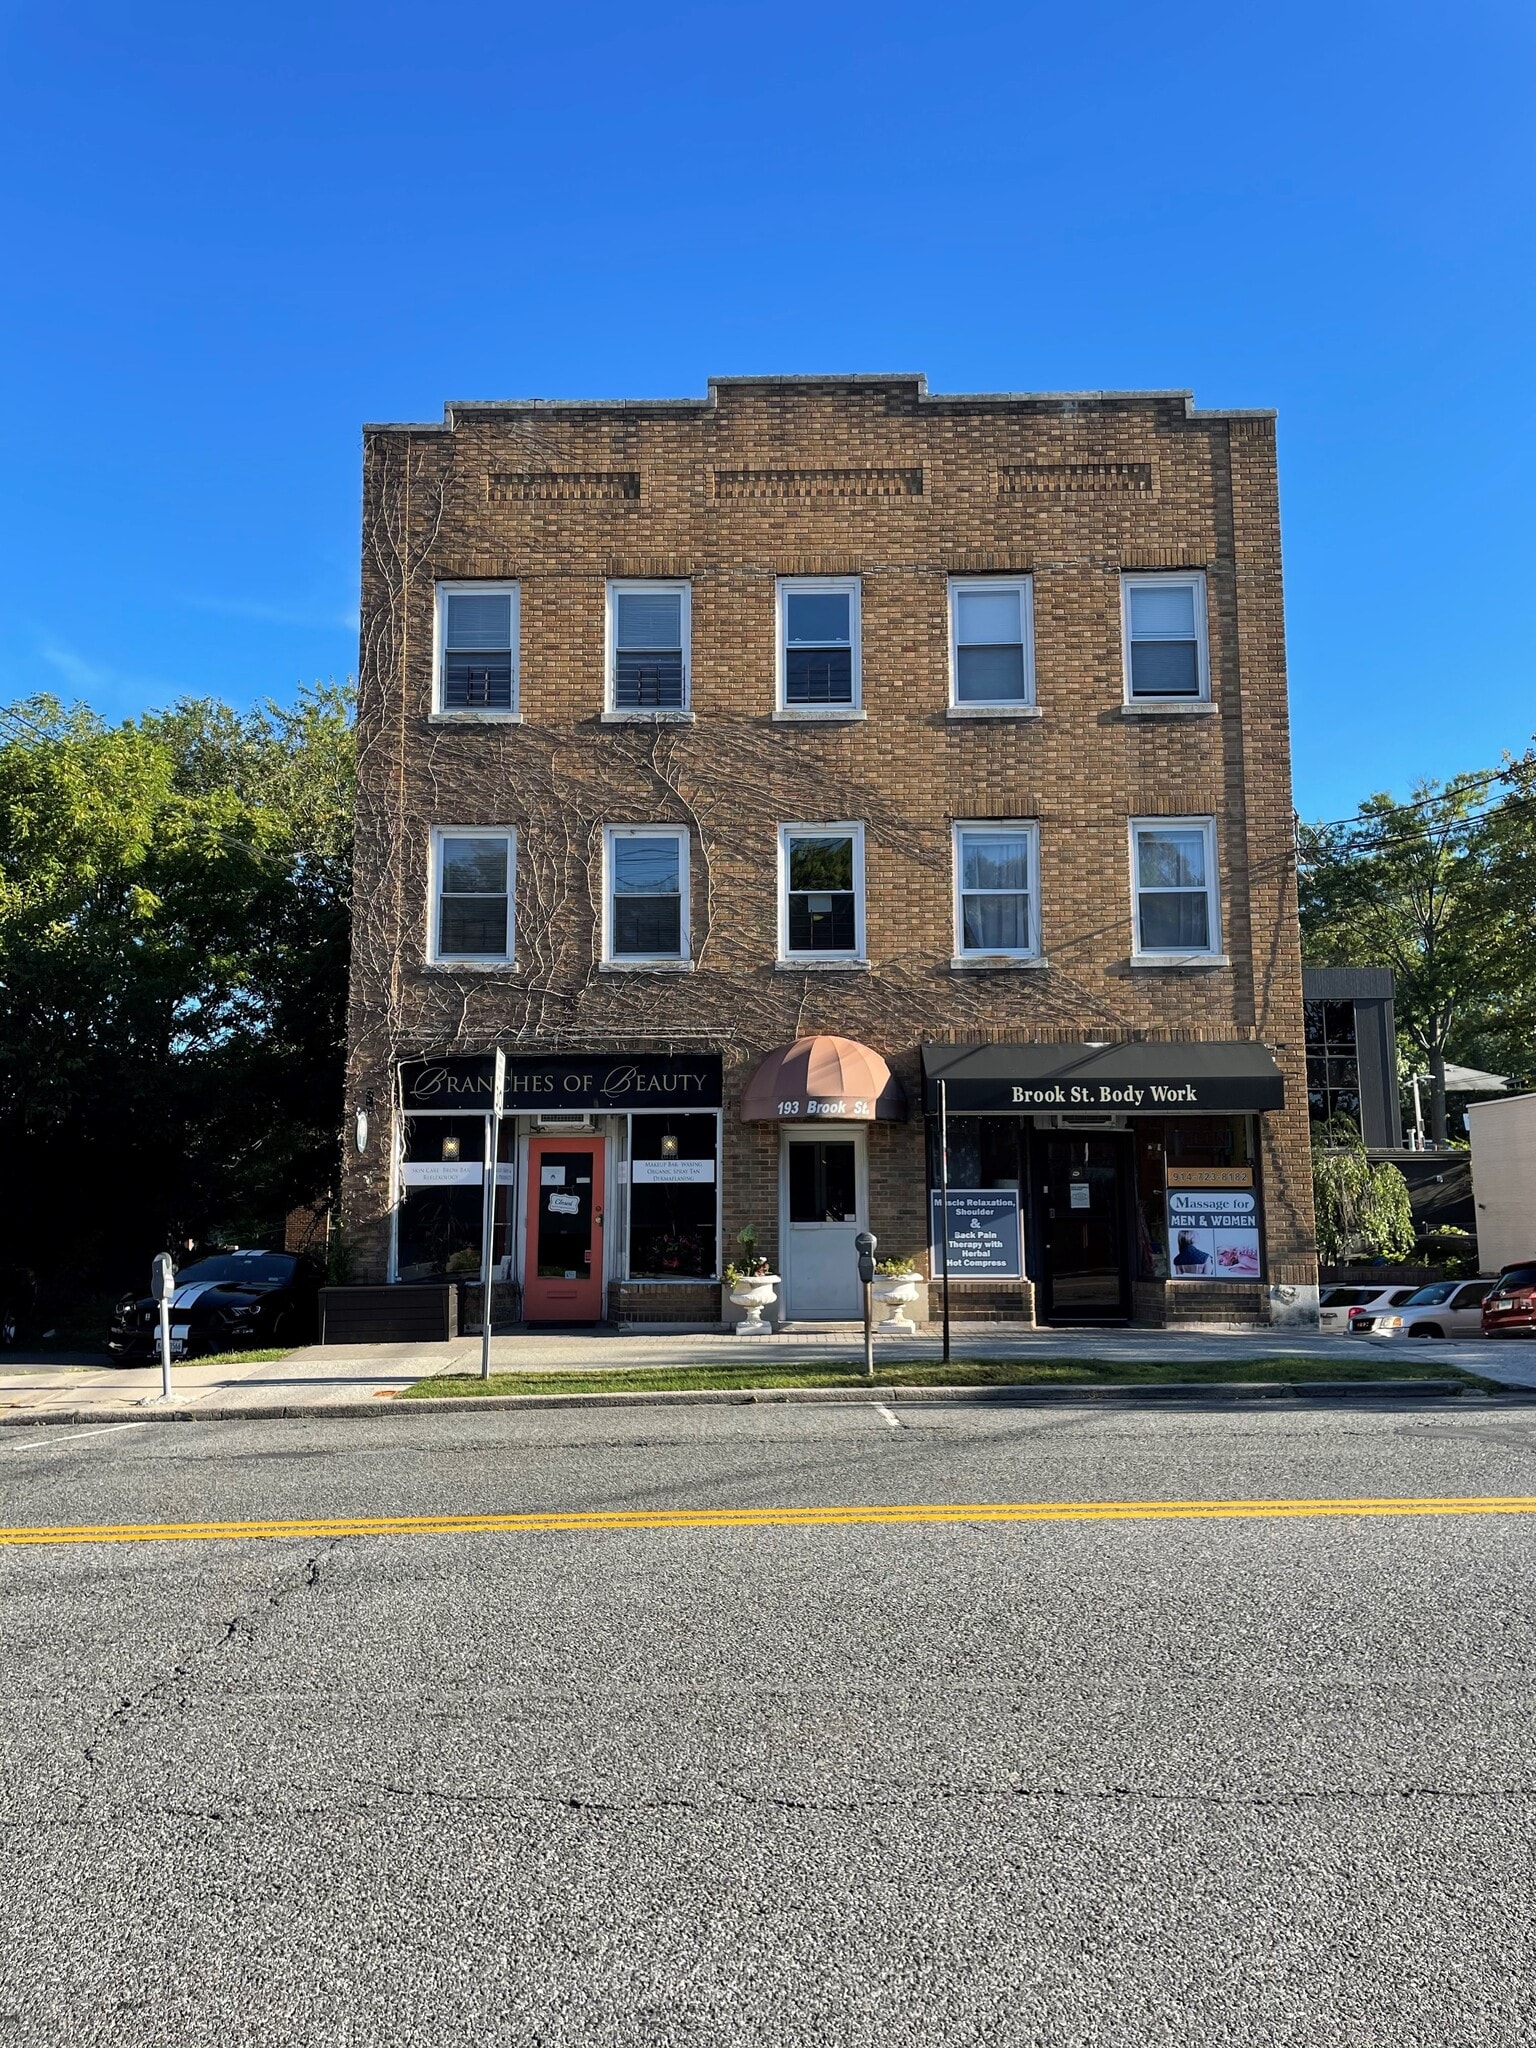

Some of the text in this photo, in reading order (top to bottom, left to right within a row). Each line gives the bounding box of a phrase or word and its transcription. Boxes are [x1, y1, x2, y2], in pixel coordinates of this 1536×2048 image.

[563, 1074, 593, 1092] OF
[599, 1065, 707, 1098] BEAUTY
[1011, 1084, 1198, 1106] Brook St. Body Work
[777, 1100, 870, 1115] 193 Brook St.
[1172, 1172, 1248, 1182] 914-723-8182
[967, 1199, 1016, 1207] Relaxation,
[1175, 1196, 1250, 1211] Massage for
[956, 1208, 994, 1216] Shoulder
[970, 1218, 981, 1229] &
[1170, 1215, 1256, 1227] MEN & WOMEN
[954, 1231, 998, 1239] Back Pain
[948, 1241, 984, 1249] Therapy
[961, 1250, 991, 1258] Herbal
[946, 1259, 1007, 1268] Hot Compress
